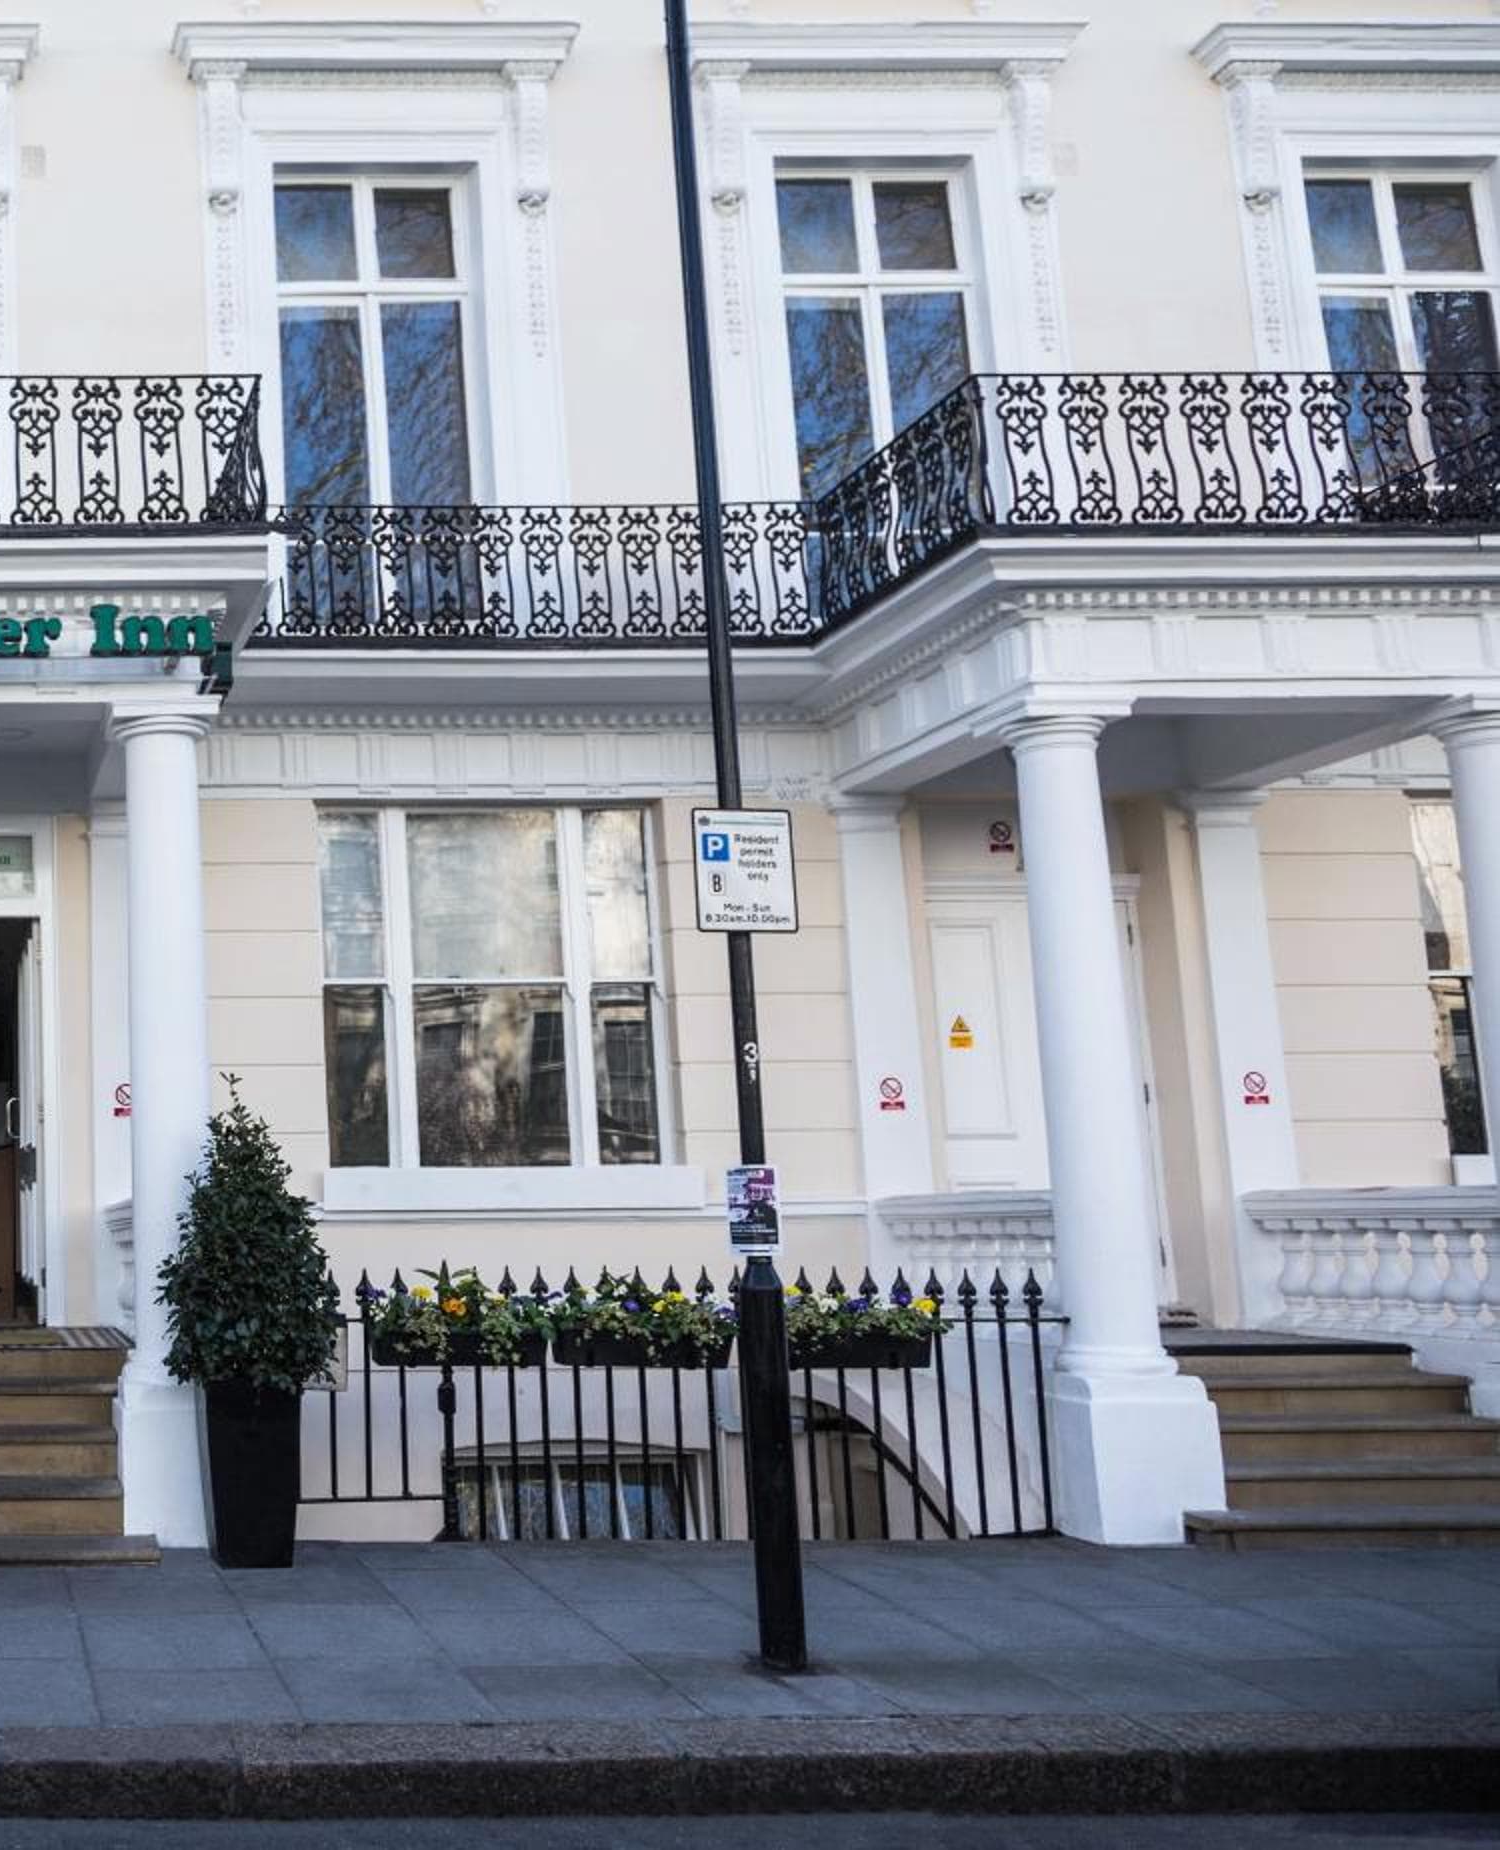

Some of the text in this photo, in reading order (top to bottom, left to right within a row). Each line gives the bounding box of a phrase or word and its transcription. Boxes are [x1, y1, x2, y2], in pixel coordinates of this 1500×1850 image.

[91, 605, 215, 657] Inn
[735, 834, 779, 844] Resident
[707, 835, 724, 858] P
[740, 848, 773, 857] permit
[738, 860, 777, 869] holders
[747, 872, 769, 881] only
[712, 873, 722, 892] B
[723, 903, 743, 912] Mon
[752, 903, 771, 912] Sun
